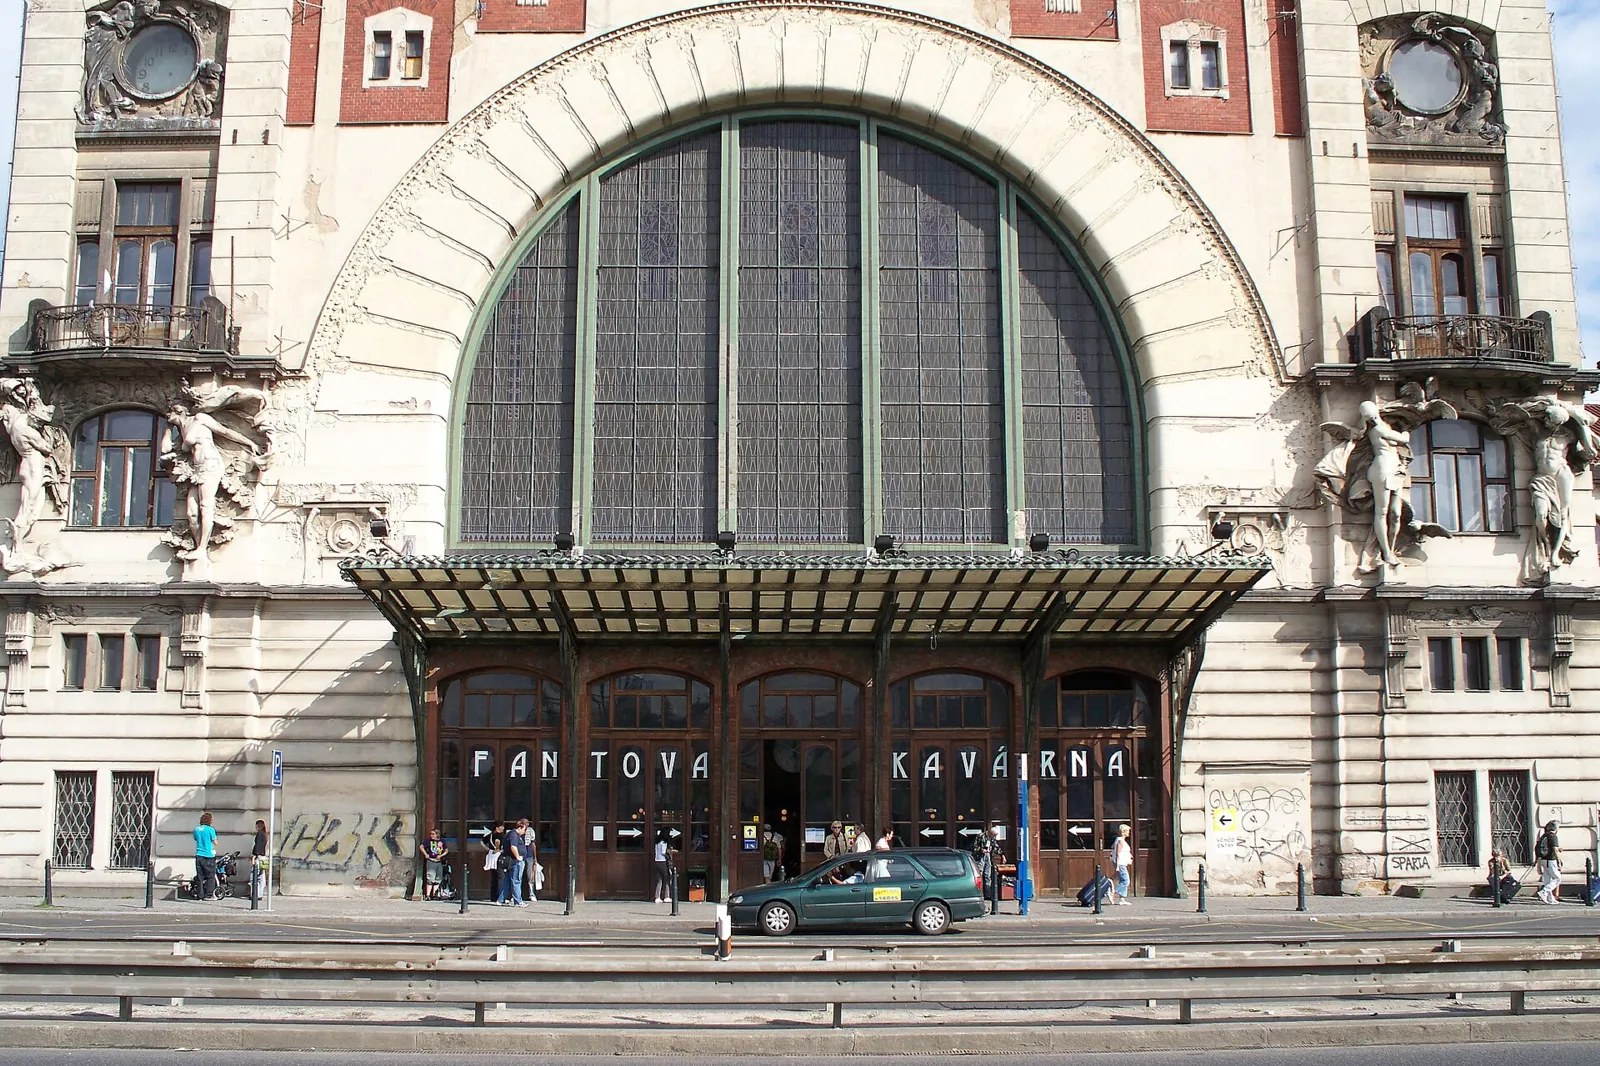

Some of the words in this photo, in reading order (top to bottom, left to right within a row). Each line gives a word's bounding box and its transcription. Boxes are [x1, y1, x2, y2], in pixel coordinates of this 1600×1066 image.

[144, 57, 154, 67] 10
[138, 69, 147, 79] 9
[141, 82, 150, 92] 8
[275, 755, 281, 775] P
[473, 750, 709, 779] FANTOVA
[892, 745, 1124, 779] KAVÁRNA
[1391, 856, 1431, 871] SPARTA
